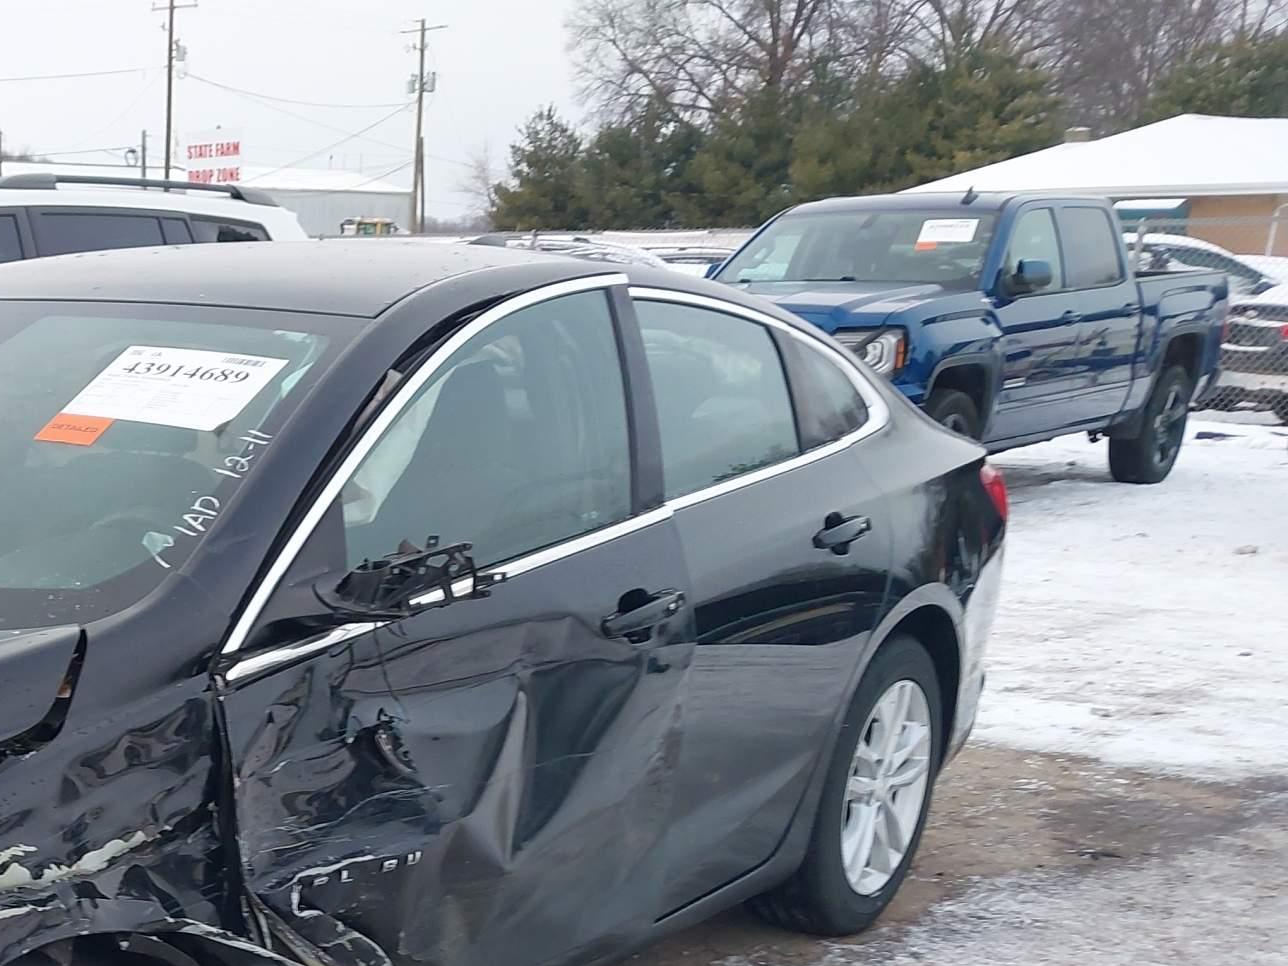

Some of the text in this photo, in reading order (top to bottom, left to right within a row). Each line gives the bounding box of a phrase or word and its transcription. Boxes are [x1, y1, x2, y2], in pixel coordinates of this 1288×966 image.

[187, 141, 240, 160] STATE FARM
[188, 167, 240, 183] DROP ZONE
[123, 361, 251, 384] 43914689
[212, 429, 273, 478] 12-11
